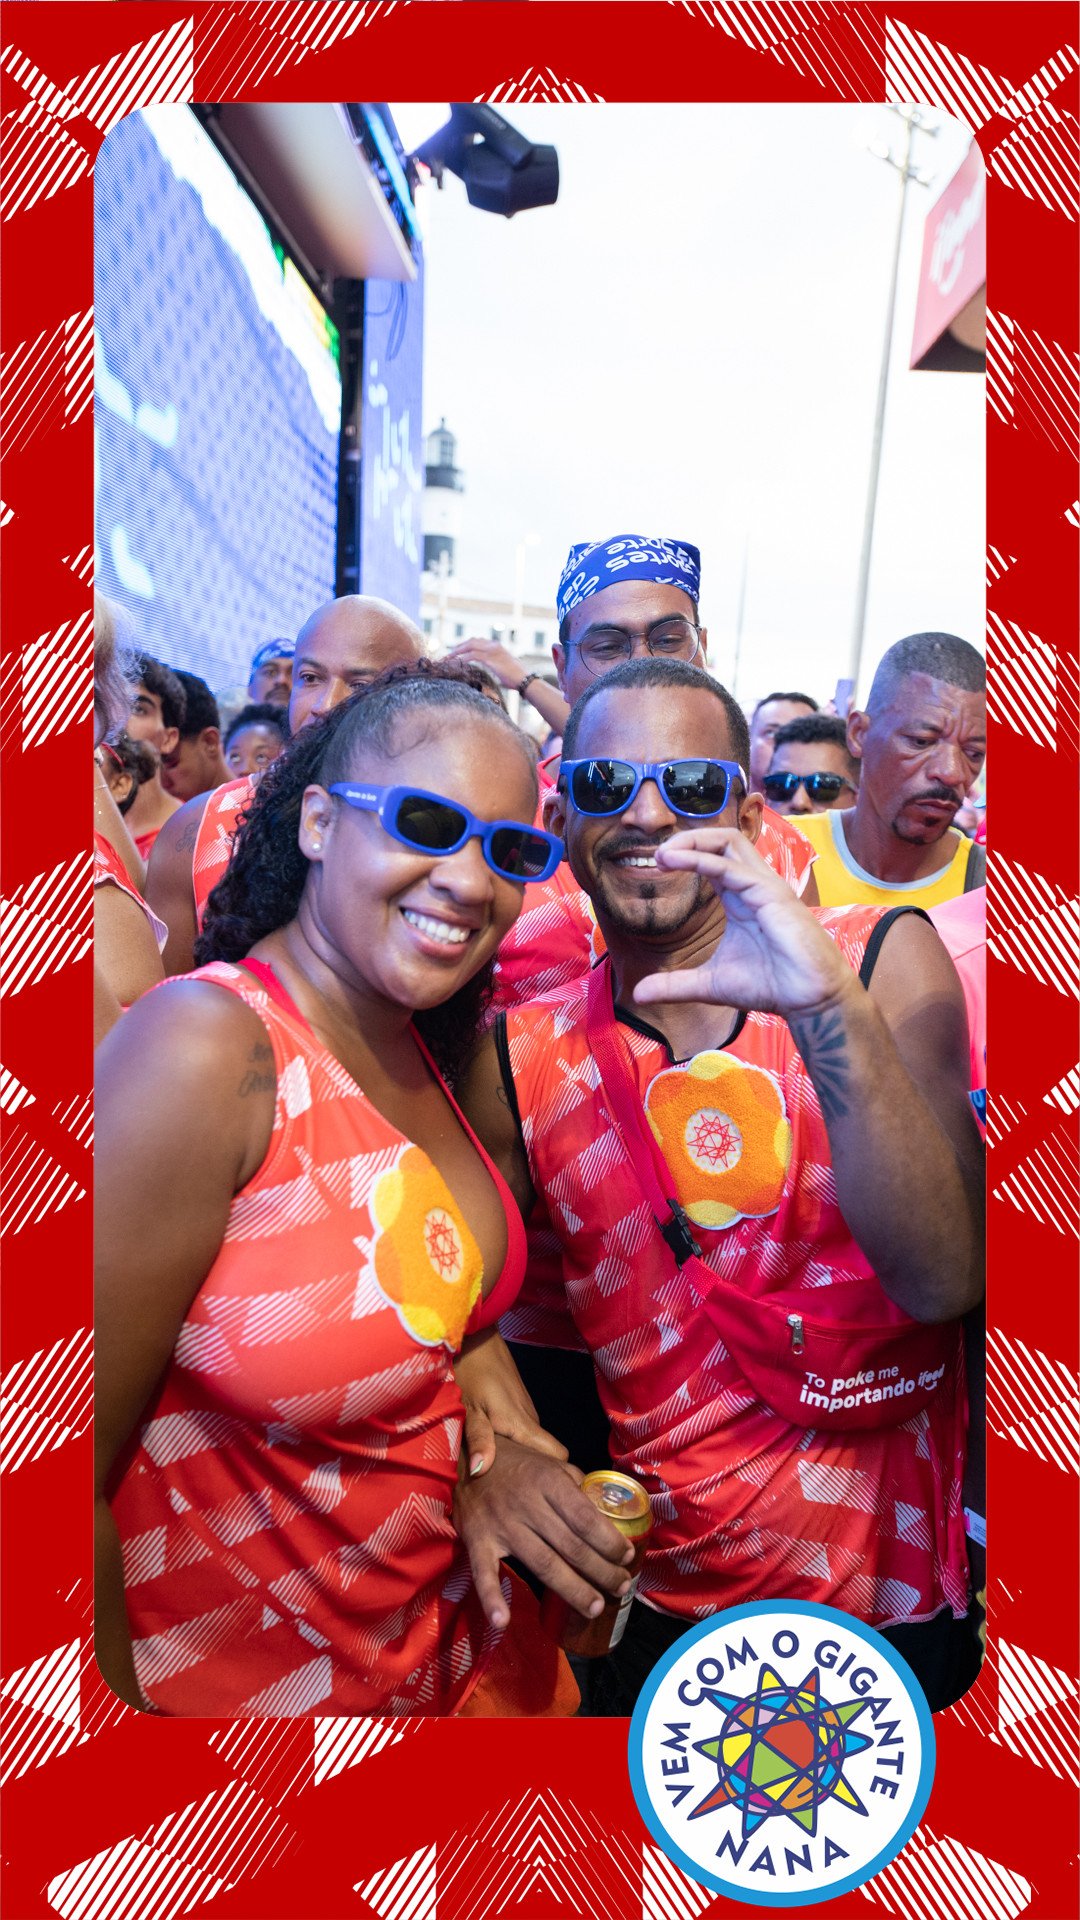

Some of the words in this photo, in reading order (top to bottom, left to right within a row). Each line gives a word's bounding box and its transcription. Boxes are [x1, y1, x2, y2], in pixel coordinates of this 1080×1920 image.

[800, 1377, 916, 1413] importando
[805, 1371, 826, 1388] To
[830, 1370, 875, 1395] poke
[878, 1366, 900, 1380] me
